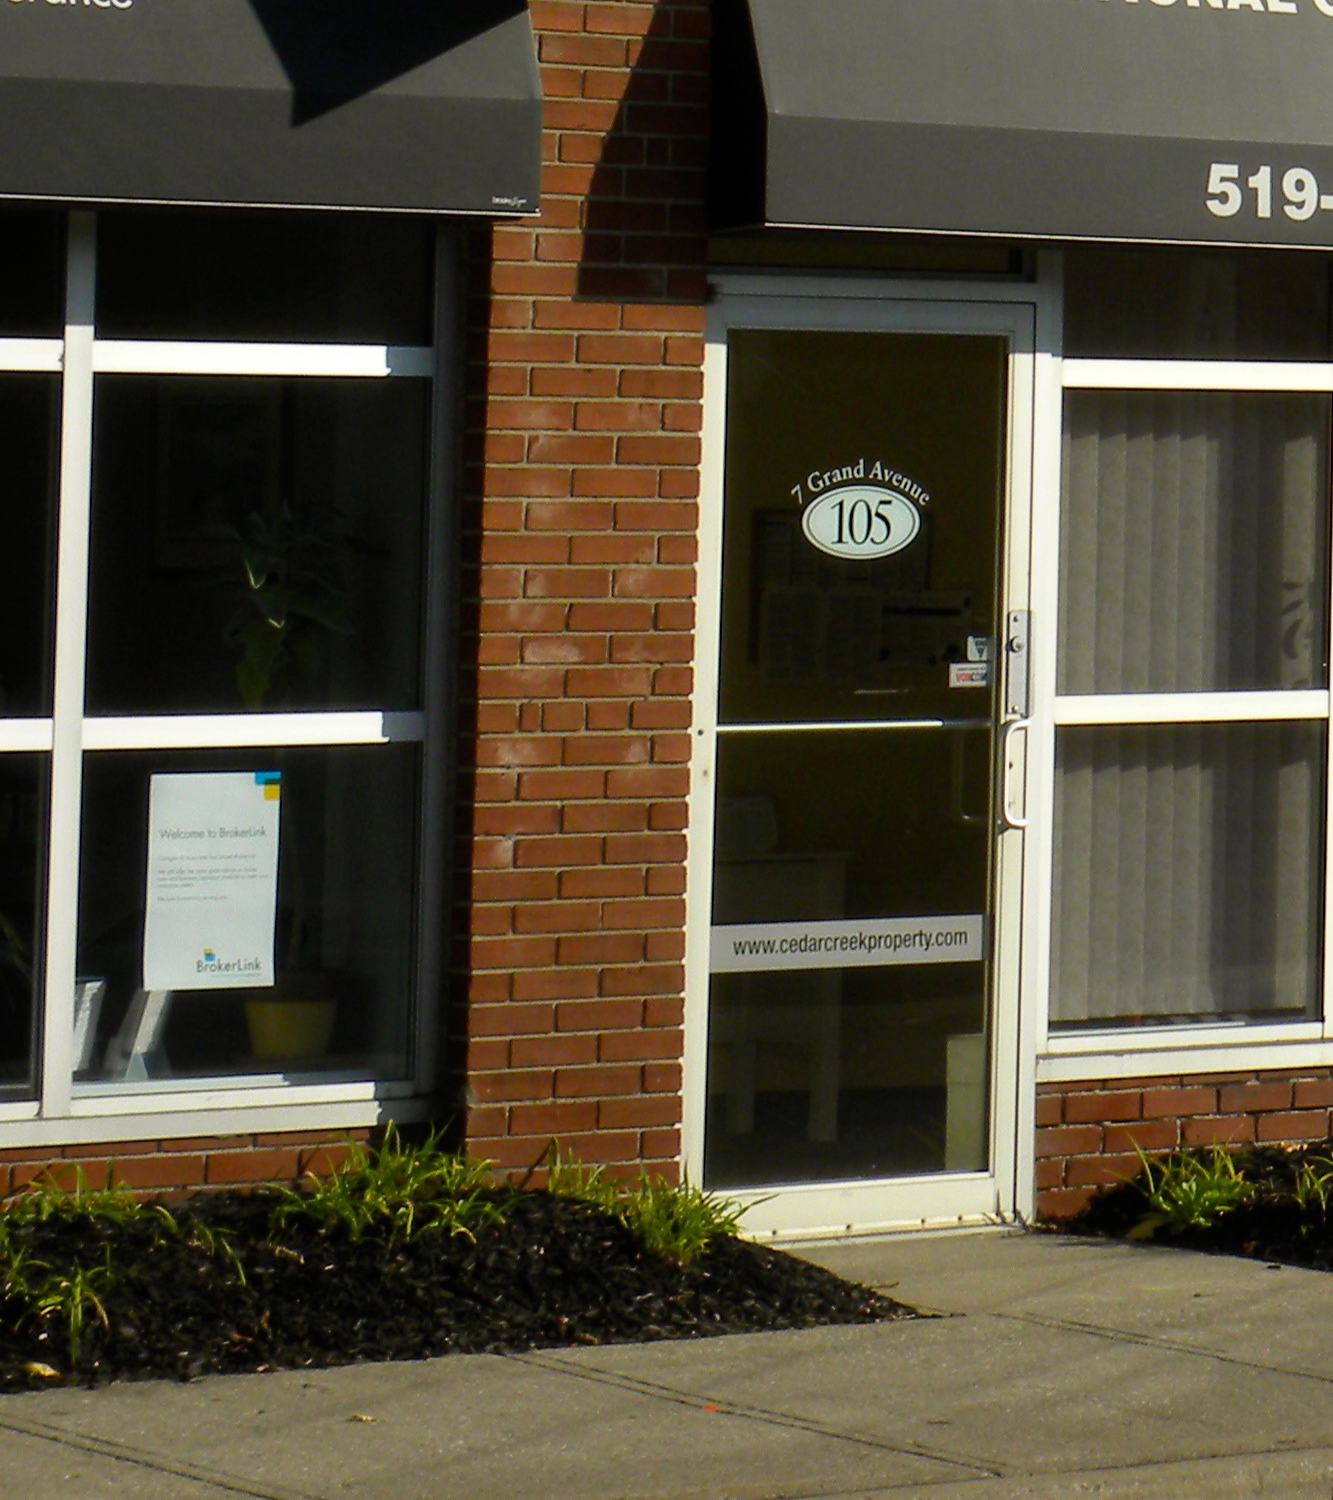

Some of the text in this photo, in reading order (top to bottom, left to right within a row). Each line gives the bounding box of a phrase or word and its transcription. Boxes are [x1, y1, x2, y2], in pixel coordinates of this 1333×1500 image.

[790, 458, 931, 506] 7 Grand Avenue
[831, 499, 893, 546] 105
[160, 828, 205, 839] Welcome
[207, 828, 217, 839] to
[733, 929, 968, 955] www.cedarcreekproperty.com
[196, 956, 262, 973] BrokerLink
